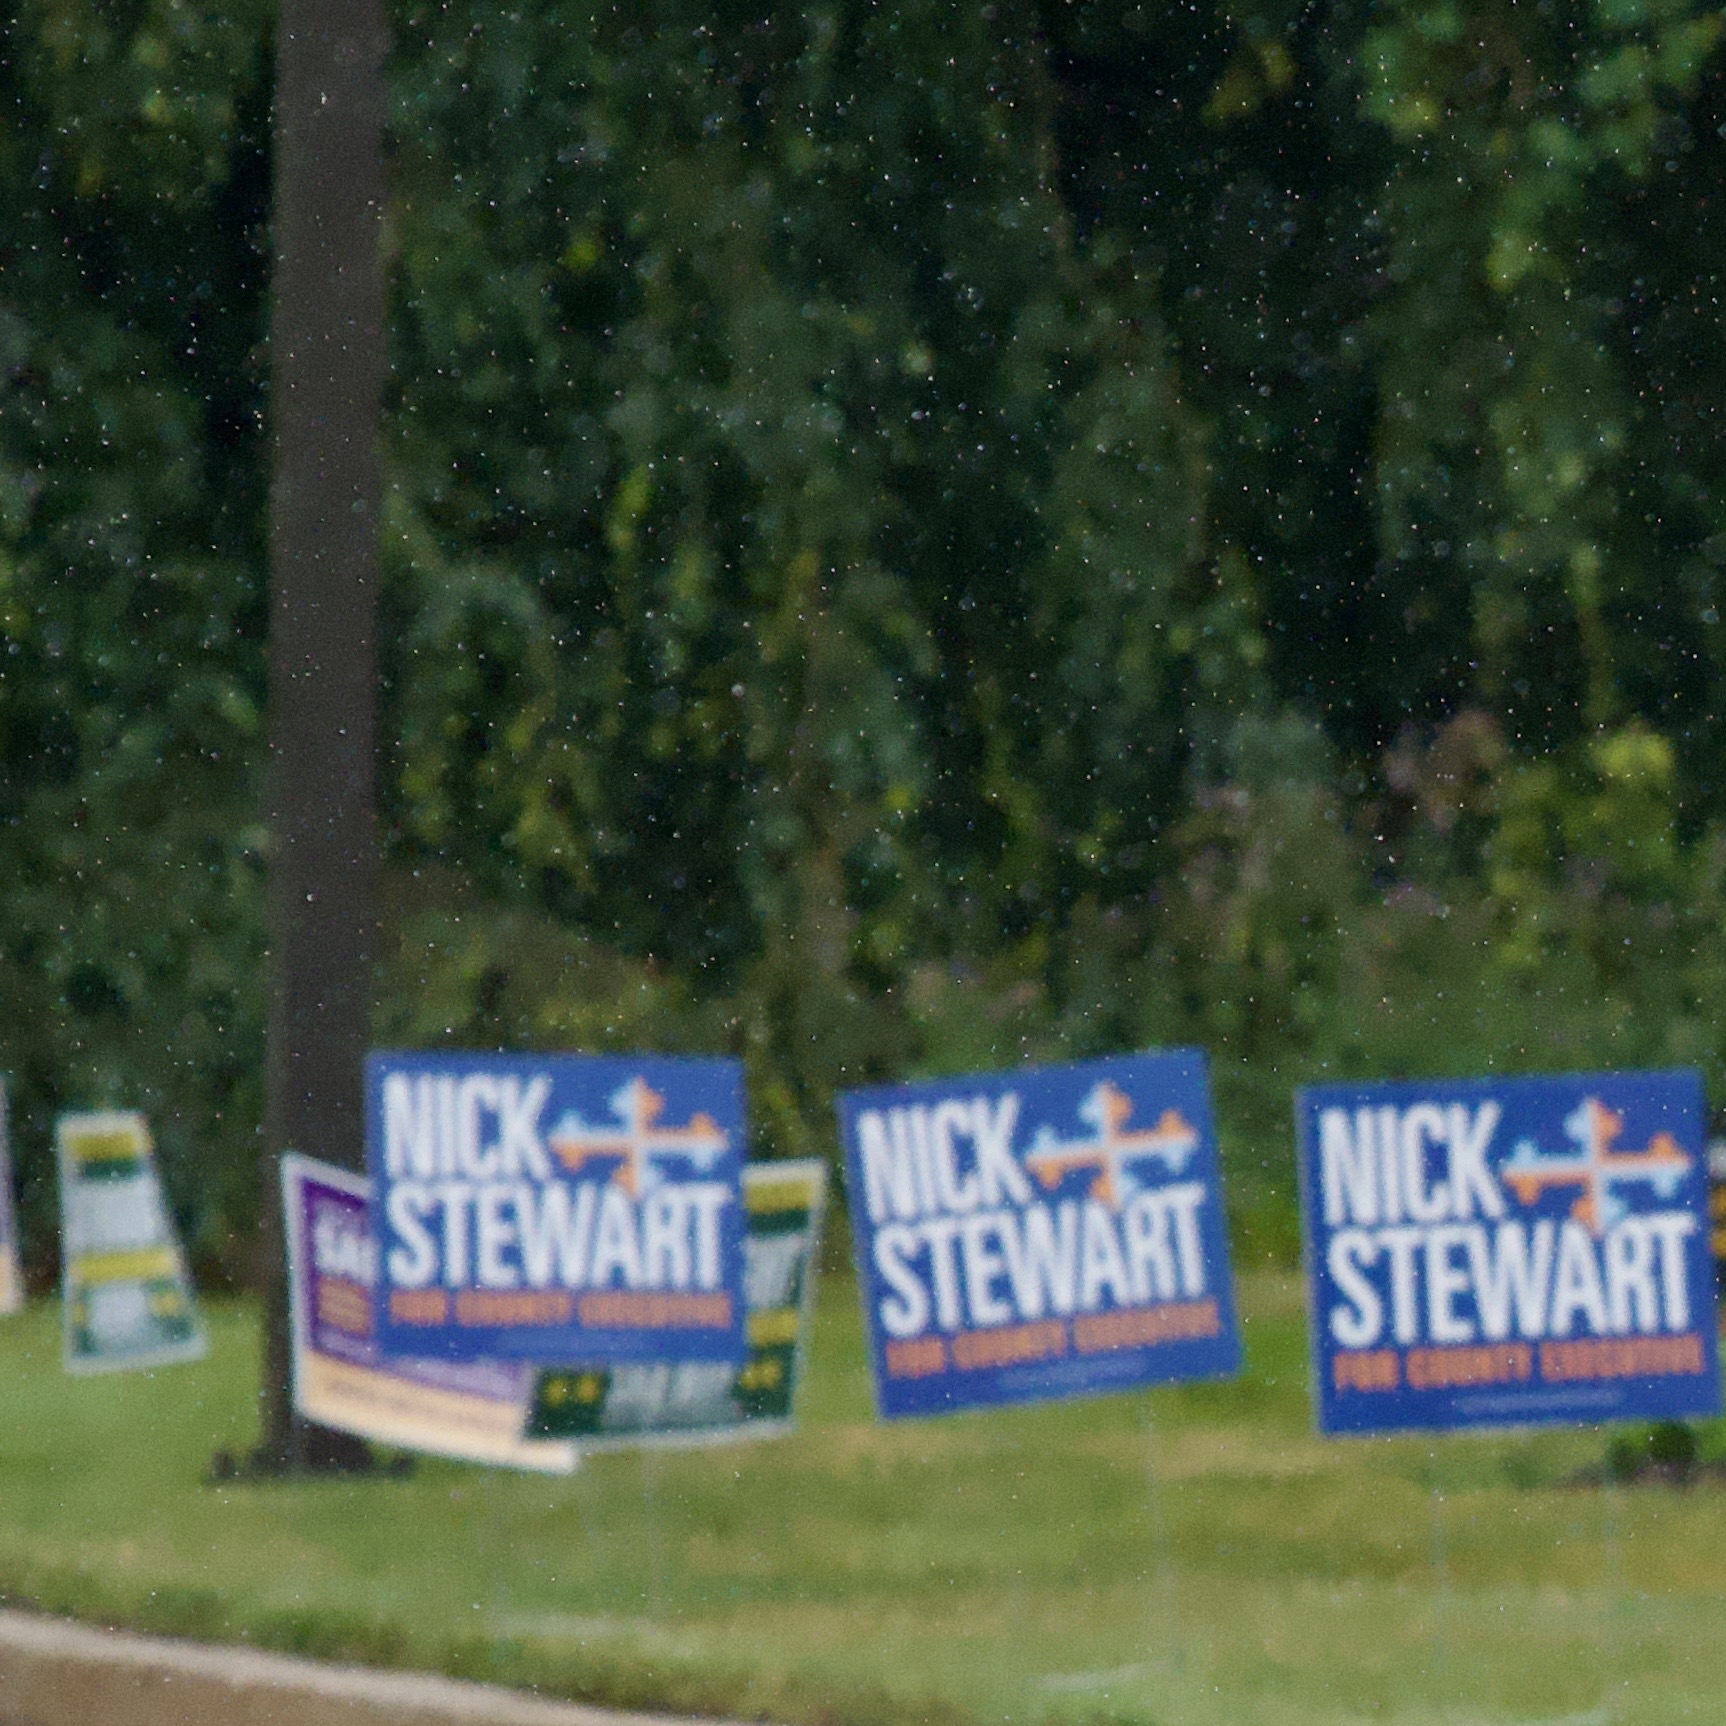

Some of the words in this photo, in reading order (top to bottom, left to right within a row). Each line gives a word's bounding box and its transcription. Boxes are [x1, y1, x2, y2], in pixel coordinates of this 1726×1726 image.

[382, 1071, 553, 1180] NICK
[858, 1092, 1034, 1221] NICK
[1319, 1103, 1503, 1225] NICK
[385, 1180, 732, 1289] STEWART
[873, 1182, 1206, 1336] STEWART
[1328, 1212, 1696, 1347] STEWART
